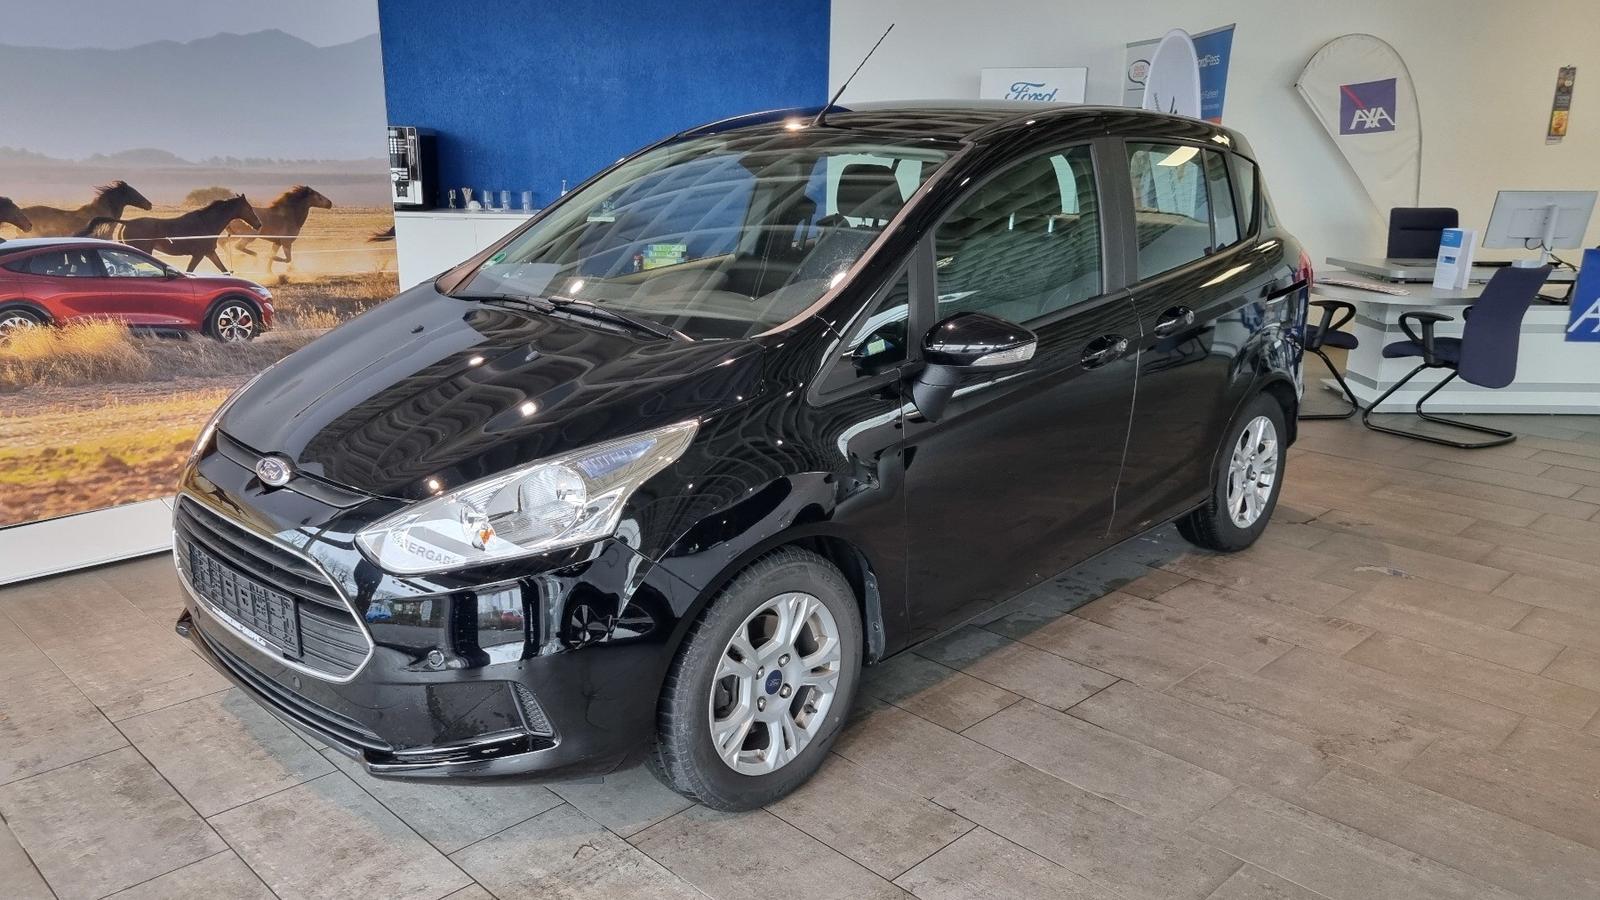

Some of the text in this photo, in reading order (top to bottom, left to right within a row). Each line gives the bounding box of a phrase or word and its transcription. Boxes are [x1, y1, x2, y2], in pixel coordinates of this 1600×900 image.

[1005, 81, 1058, 101] Ford
[1350, 107, 1396, 129] AXA
[1567, 297, 1600, 333] A
